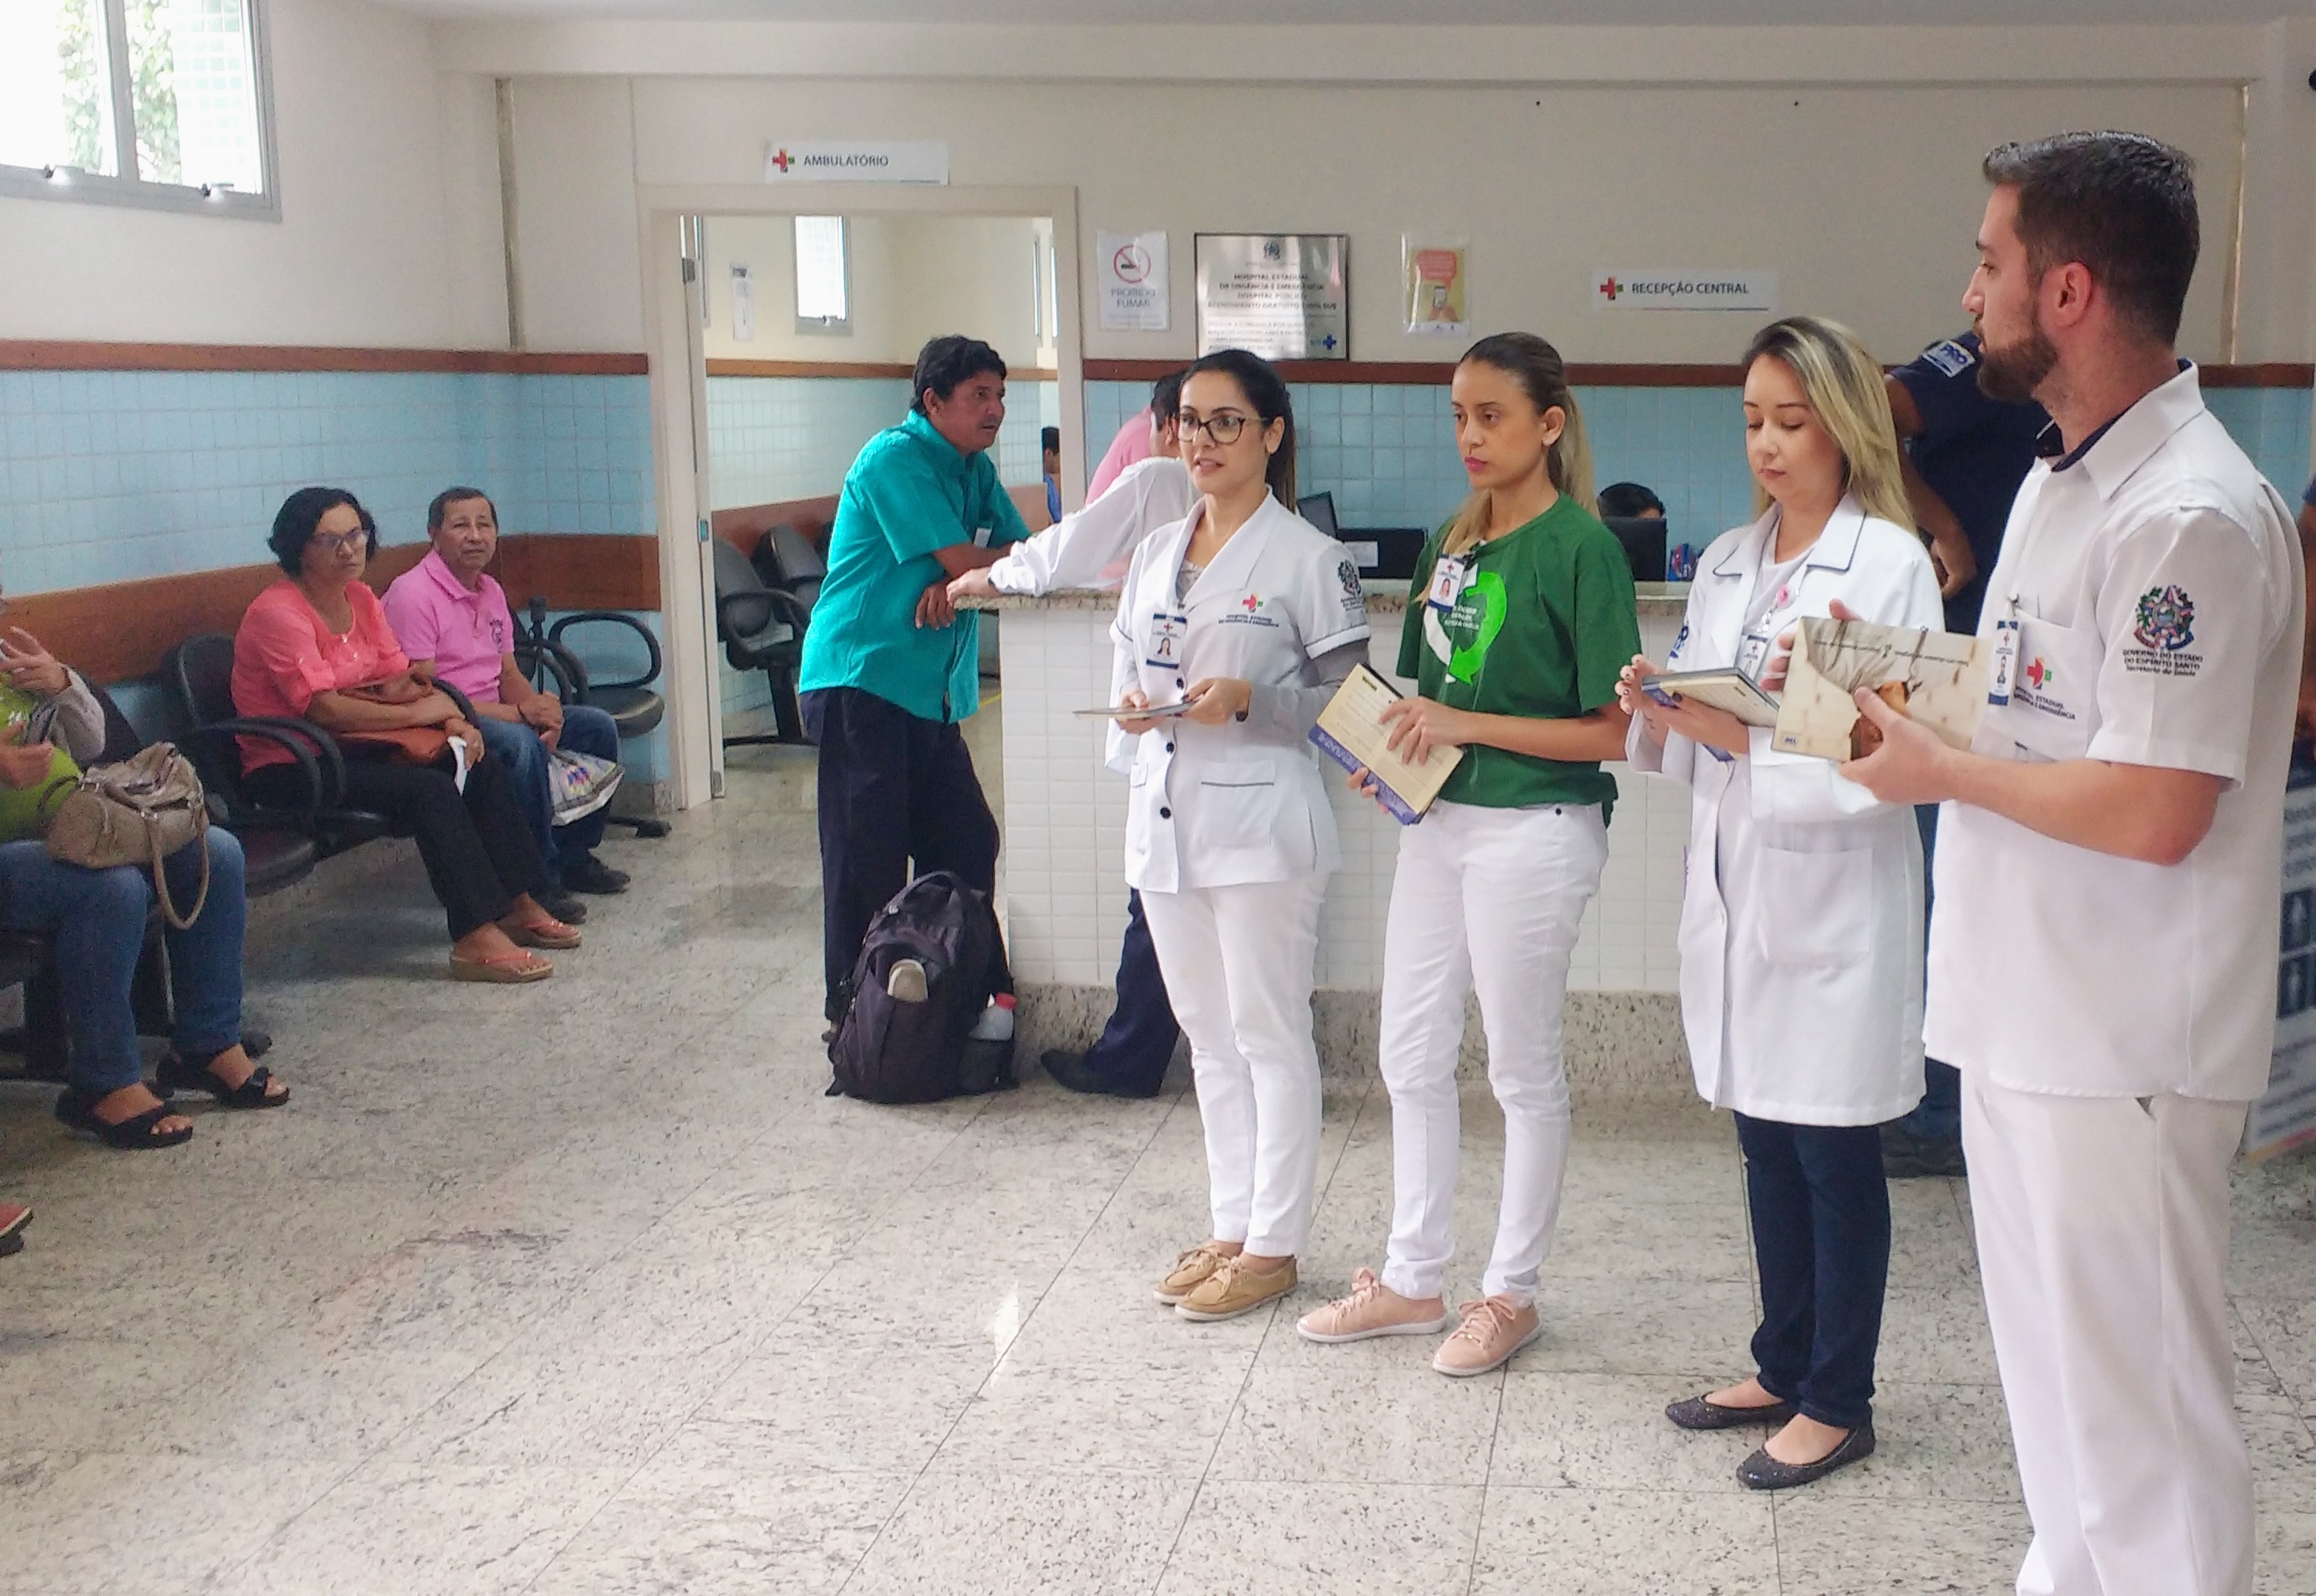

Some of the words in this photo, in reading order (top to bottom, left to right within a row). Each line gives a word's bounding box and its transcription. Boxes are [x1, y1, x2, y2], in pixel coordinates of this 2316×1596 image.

[804, 153, 889, 167] AMBULATÓRIO
[1631, 280, 1694, 296] RECEPÇÃO
[1696, 282, 1749, 294] CENTRAL
[1117, 299, 1149, 308] FUMAR
